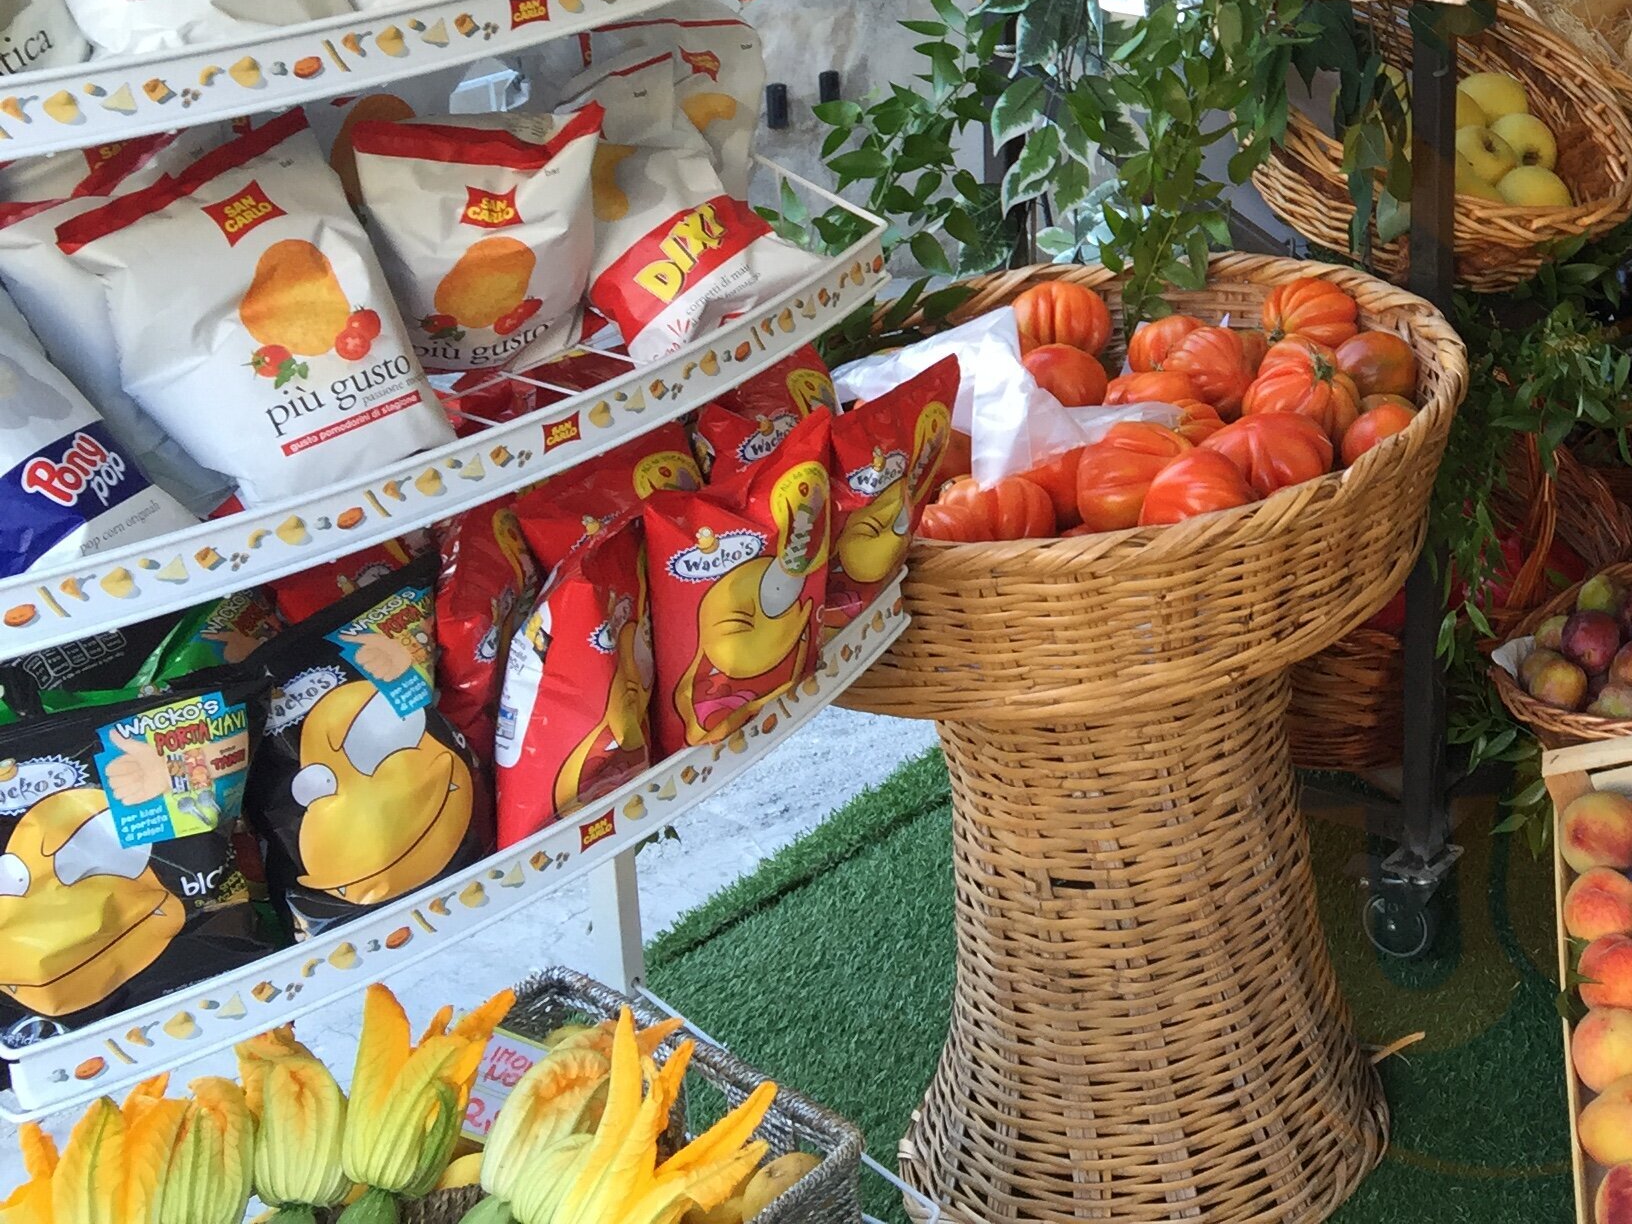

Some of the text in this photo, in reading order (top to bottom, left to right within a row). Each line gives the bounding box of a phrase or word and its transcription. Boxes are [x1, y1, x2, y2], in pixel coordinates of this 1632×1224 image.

[0, 29, 54, 75] tica
[224, 195, 257, 216] SAN
[224, 202, 273, 233] CARLO
[466, 206, 515, 224] CARLO
[479, 196, 508, 210] SAN
[469, 322, 550, 365] gusto
[265, 354, 412, 438] più gusto
[289, 393, 418, 453] gusto pomodorini di stagione
[21, 431, 109, 507] Pony
[90, 451, 126, 507] pop
[79, 535, 101, 557] pop
[102, 523, 126, 542] corn
[683, 540, 755, 573] Wacko's
[340, 590, 416, 637] WACKO'S
[273, 676, 332, 717] acko's
[115, 699, 219, 739] WACKO'S
[0, 768, 68, 803] cko's
[485, 1045, 534, 1072] IMO
